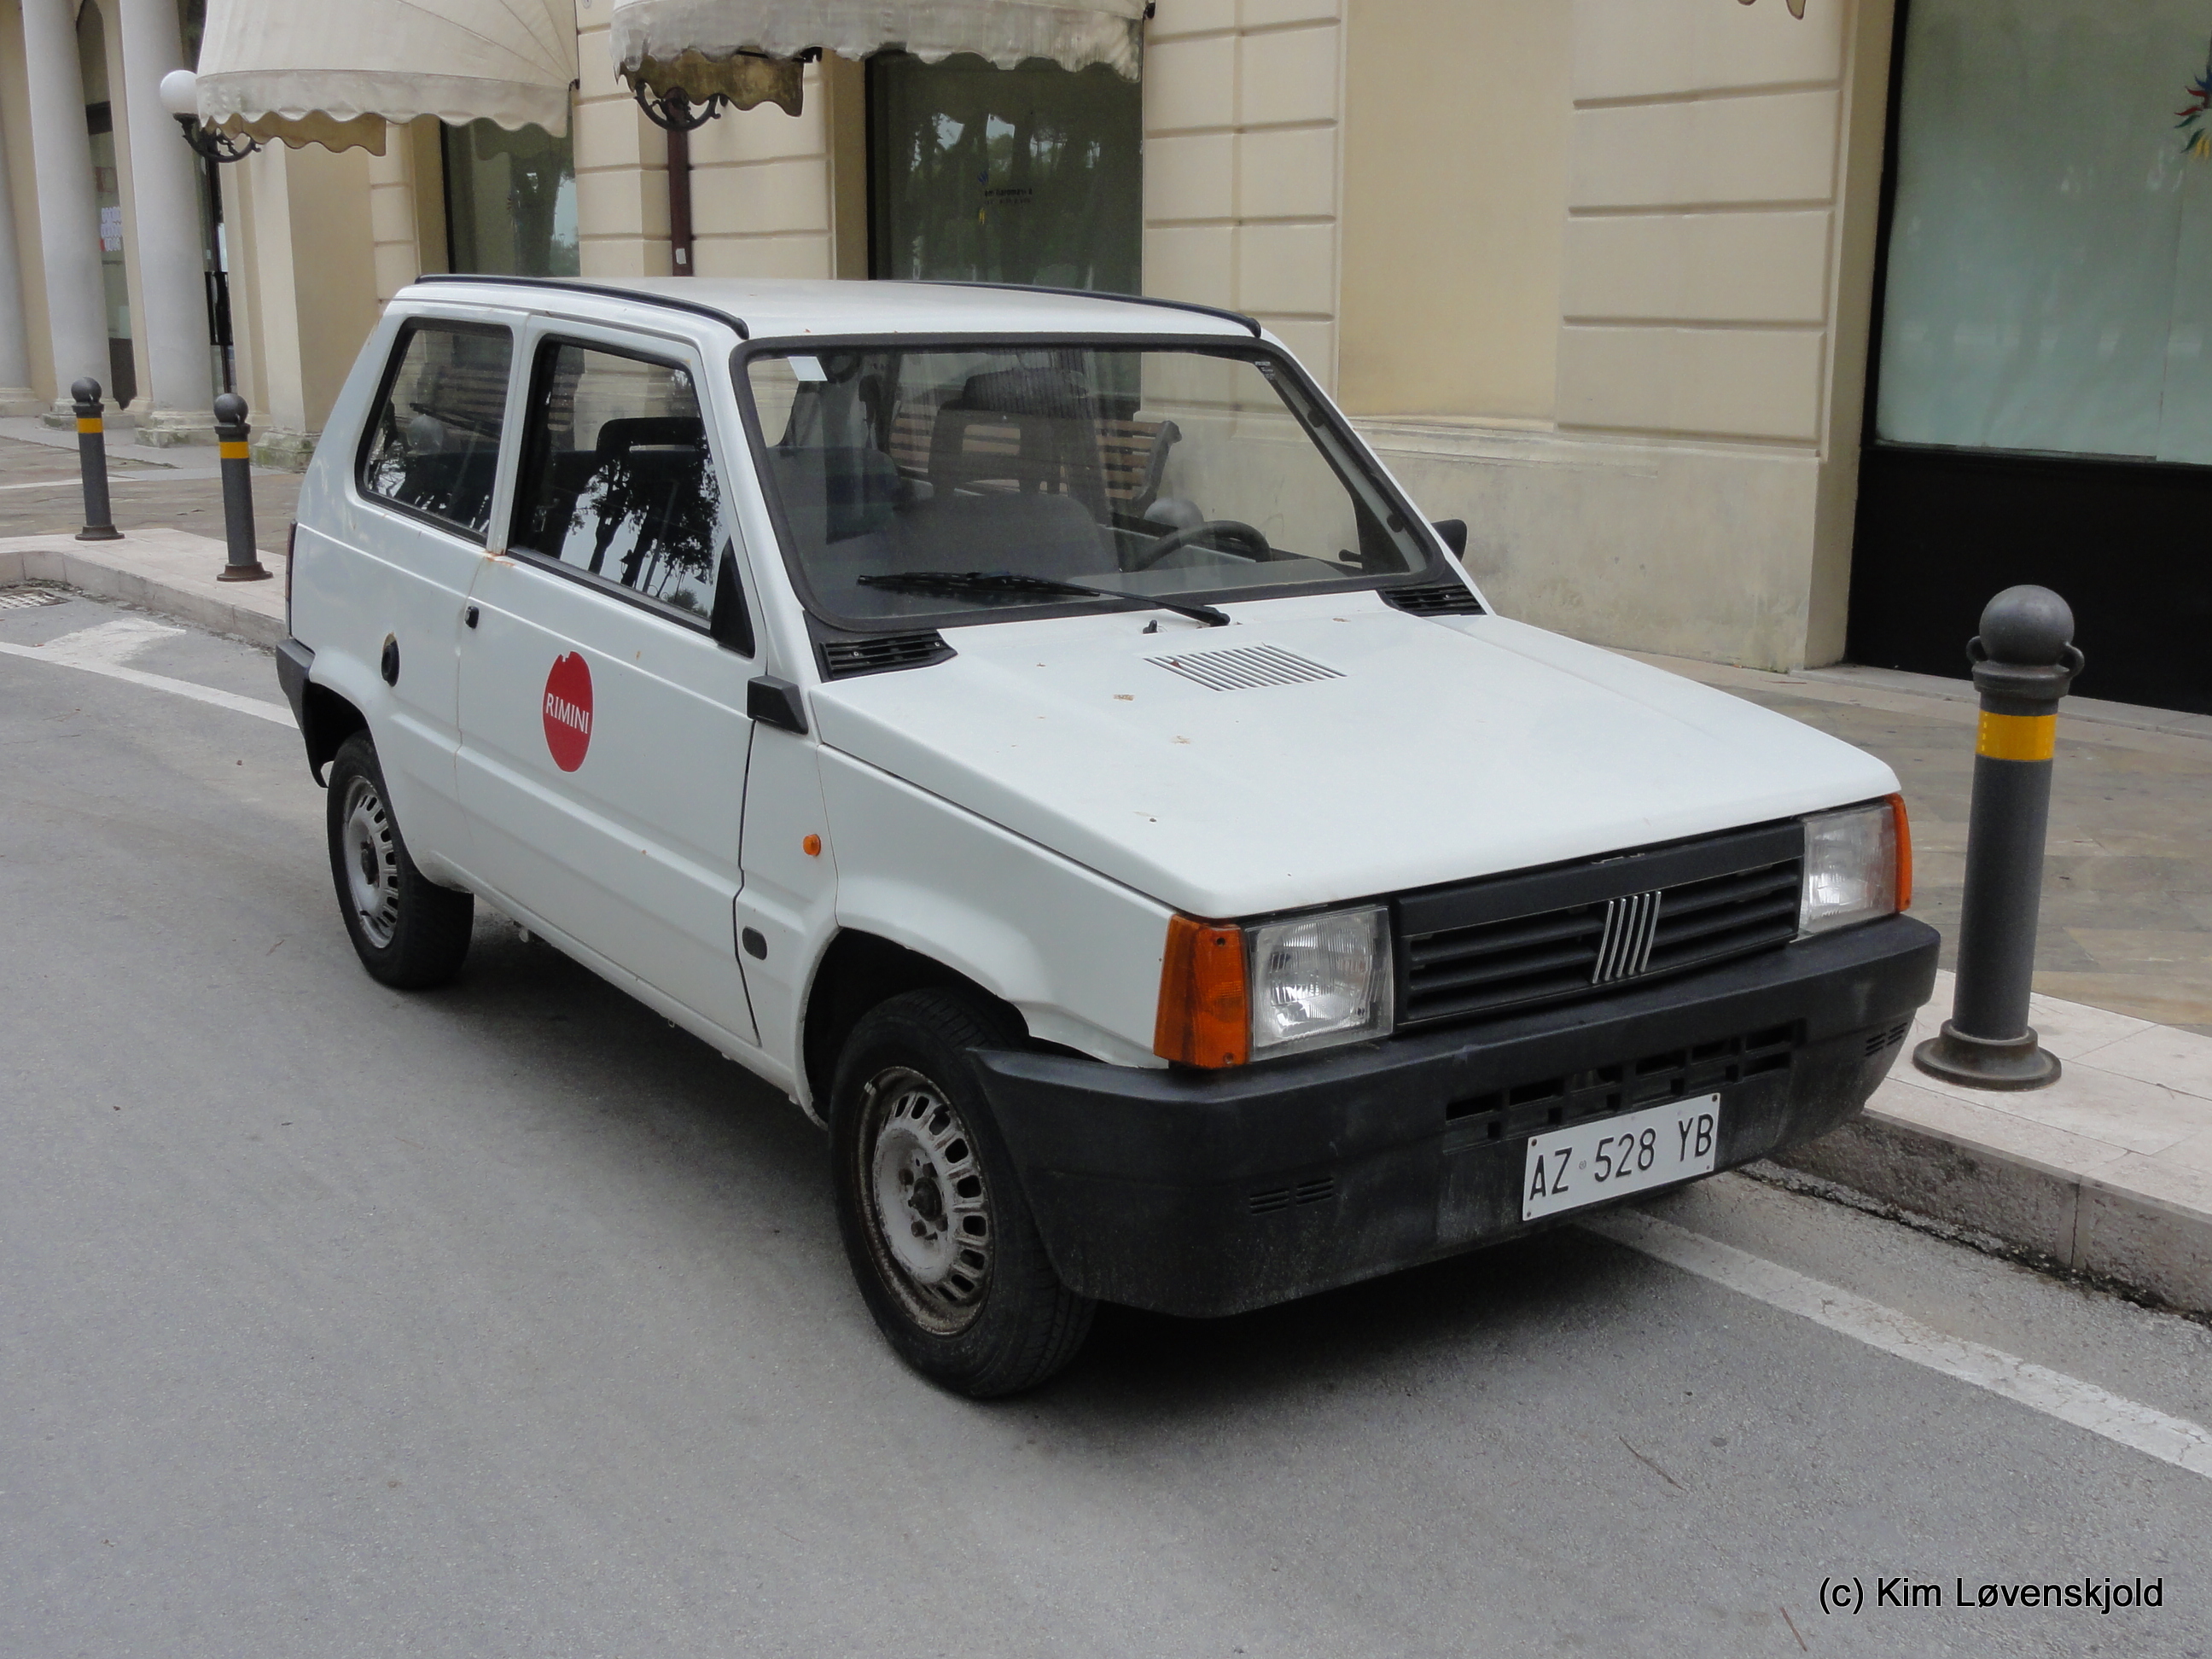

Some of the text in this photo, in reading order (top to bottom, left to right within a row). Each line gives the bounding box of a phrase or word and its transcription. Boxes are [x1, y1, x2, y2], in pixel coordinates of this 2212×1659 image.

[545, 692, 590, 735] RIMINI
[1528, 1113, 1714, 1202] AZ 528 YB
